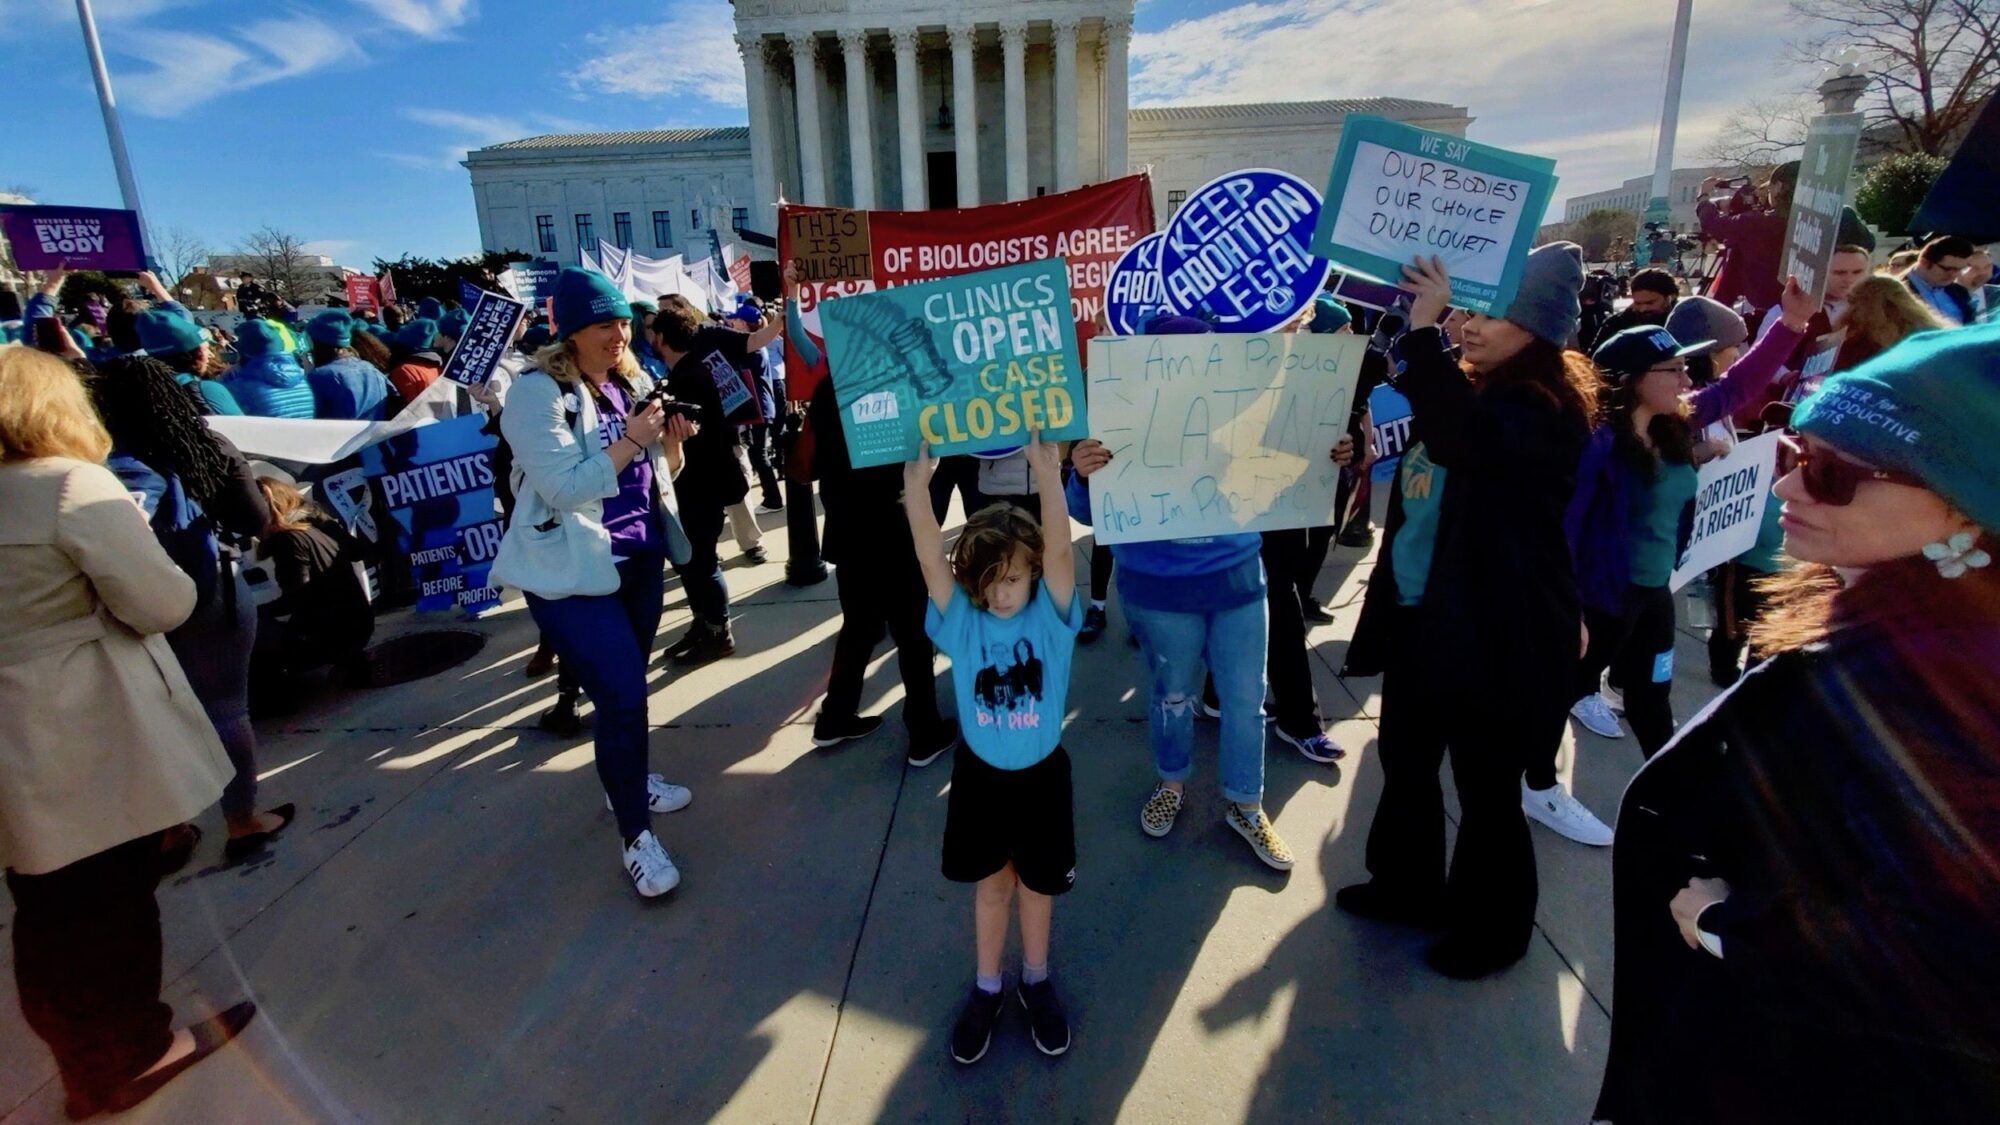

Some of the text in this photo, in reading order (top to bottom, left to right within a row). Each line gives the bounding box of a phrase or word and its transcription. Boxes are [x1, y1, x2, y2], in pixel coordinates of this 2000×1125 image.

[1420, 135, 1471, 162] WE SAY
[1382, 151, 1518, 202] OUR BODIES
[787, 213, 857, 239] THIS
[1169, 178, 1255, 260] KEEP
[1375, 186, 1506, 225] OUR CHOICE
[35, 224, 101, 243] EVERY
[40, 235, 104, 253] BODY
[809, 239, 841, 254] IS
[1168, 182, 1313, 310] ABORTION
[1369, 212, 1497, 253] OUR COURT
[794, 252, 870, 283] BULLSHIT
[883, 246, 913, 274] OF
[919, 234, 1049, 272] BIOLOGISTS
[923, 274, 1055, 324] CLINICS
[458, 298, 508, 384] PRO-LIFE
[459, 339, 477, 363] AM
[474, 301, 495, 332] THE
[471, 305, 516, 385] GENERATION
[953, 307, 1063, 365] OPEN
[980, 354, 1068, 393] CASE
[1093, 338, 1344, 383] I Am A Proud
[858, 393, 896, 421] naf
[919, 386, 1074, 446] CLOSED
[1142, 387, 1347, 468] LATINA
[381, 454, 494, 508] PATIENTS
[1103, 491, 1141, 533] And
[1694, 517, 1704, 545] A
[1706, 494, 1755, 537] RIGHT.
[410, 545, 456, 567] PATIENTS
[422, 575, 464, 597] BEFORE
[457, 586, 499, 606] PROFITS
